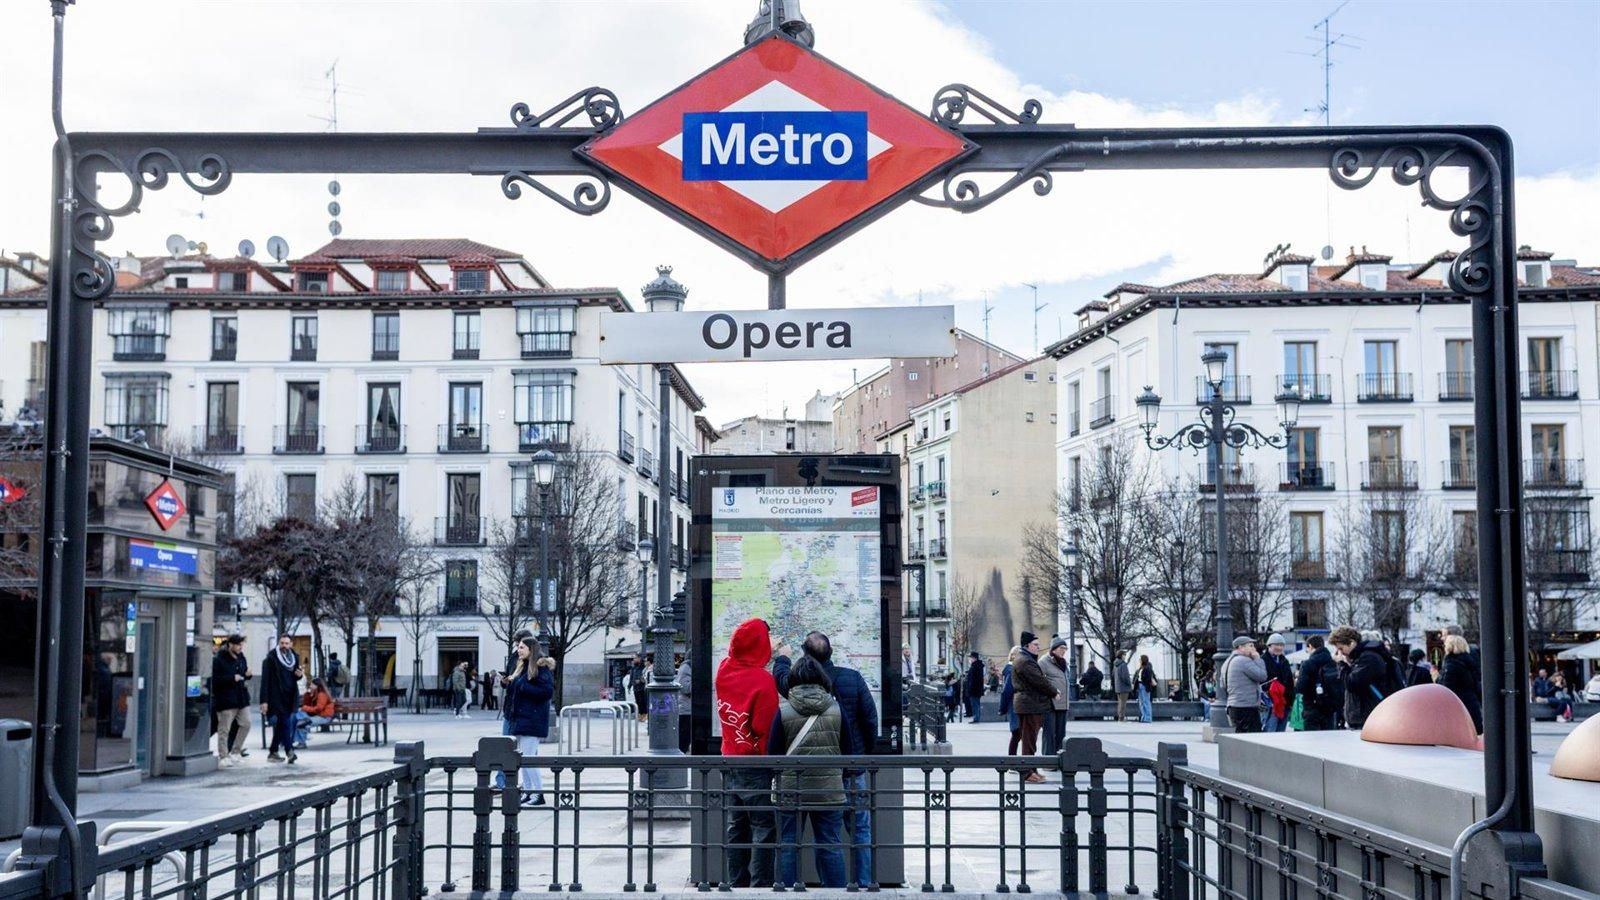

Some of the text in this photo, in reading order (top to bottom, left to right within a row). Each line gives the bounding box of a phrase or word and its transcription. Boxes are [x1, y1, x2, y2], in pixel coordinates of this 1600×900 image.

[701, 122, 854, 166] Metro
[702, 313, 852, 358] Opera
[755, 486, 785, 496] Plano
[788, 486, 801, 496] de
[158, 498, 177, 513] Metro
[759, 496, 834, 508] Metro Ligero y
[771, 506, 823, 515] Cercanías
